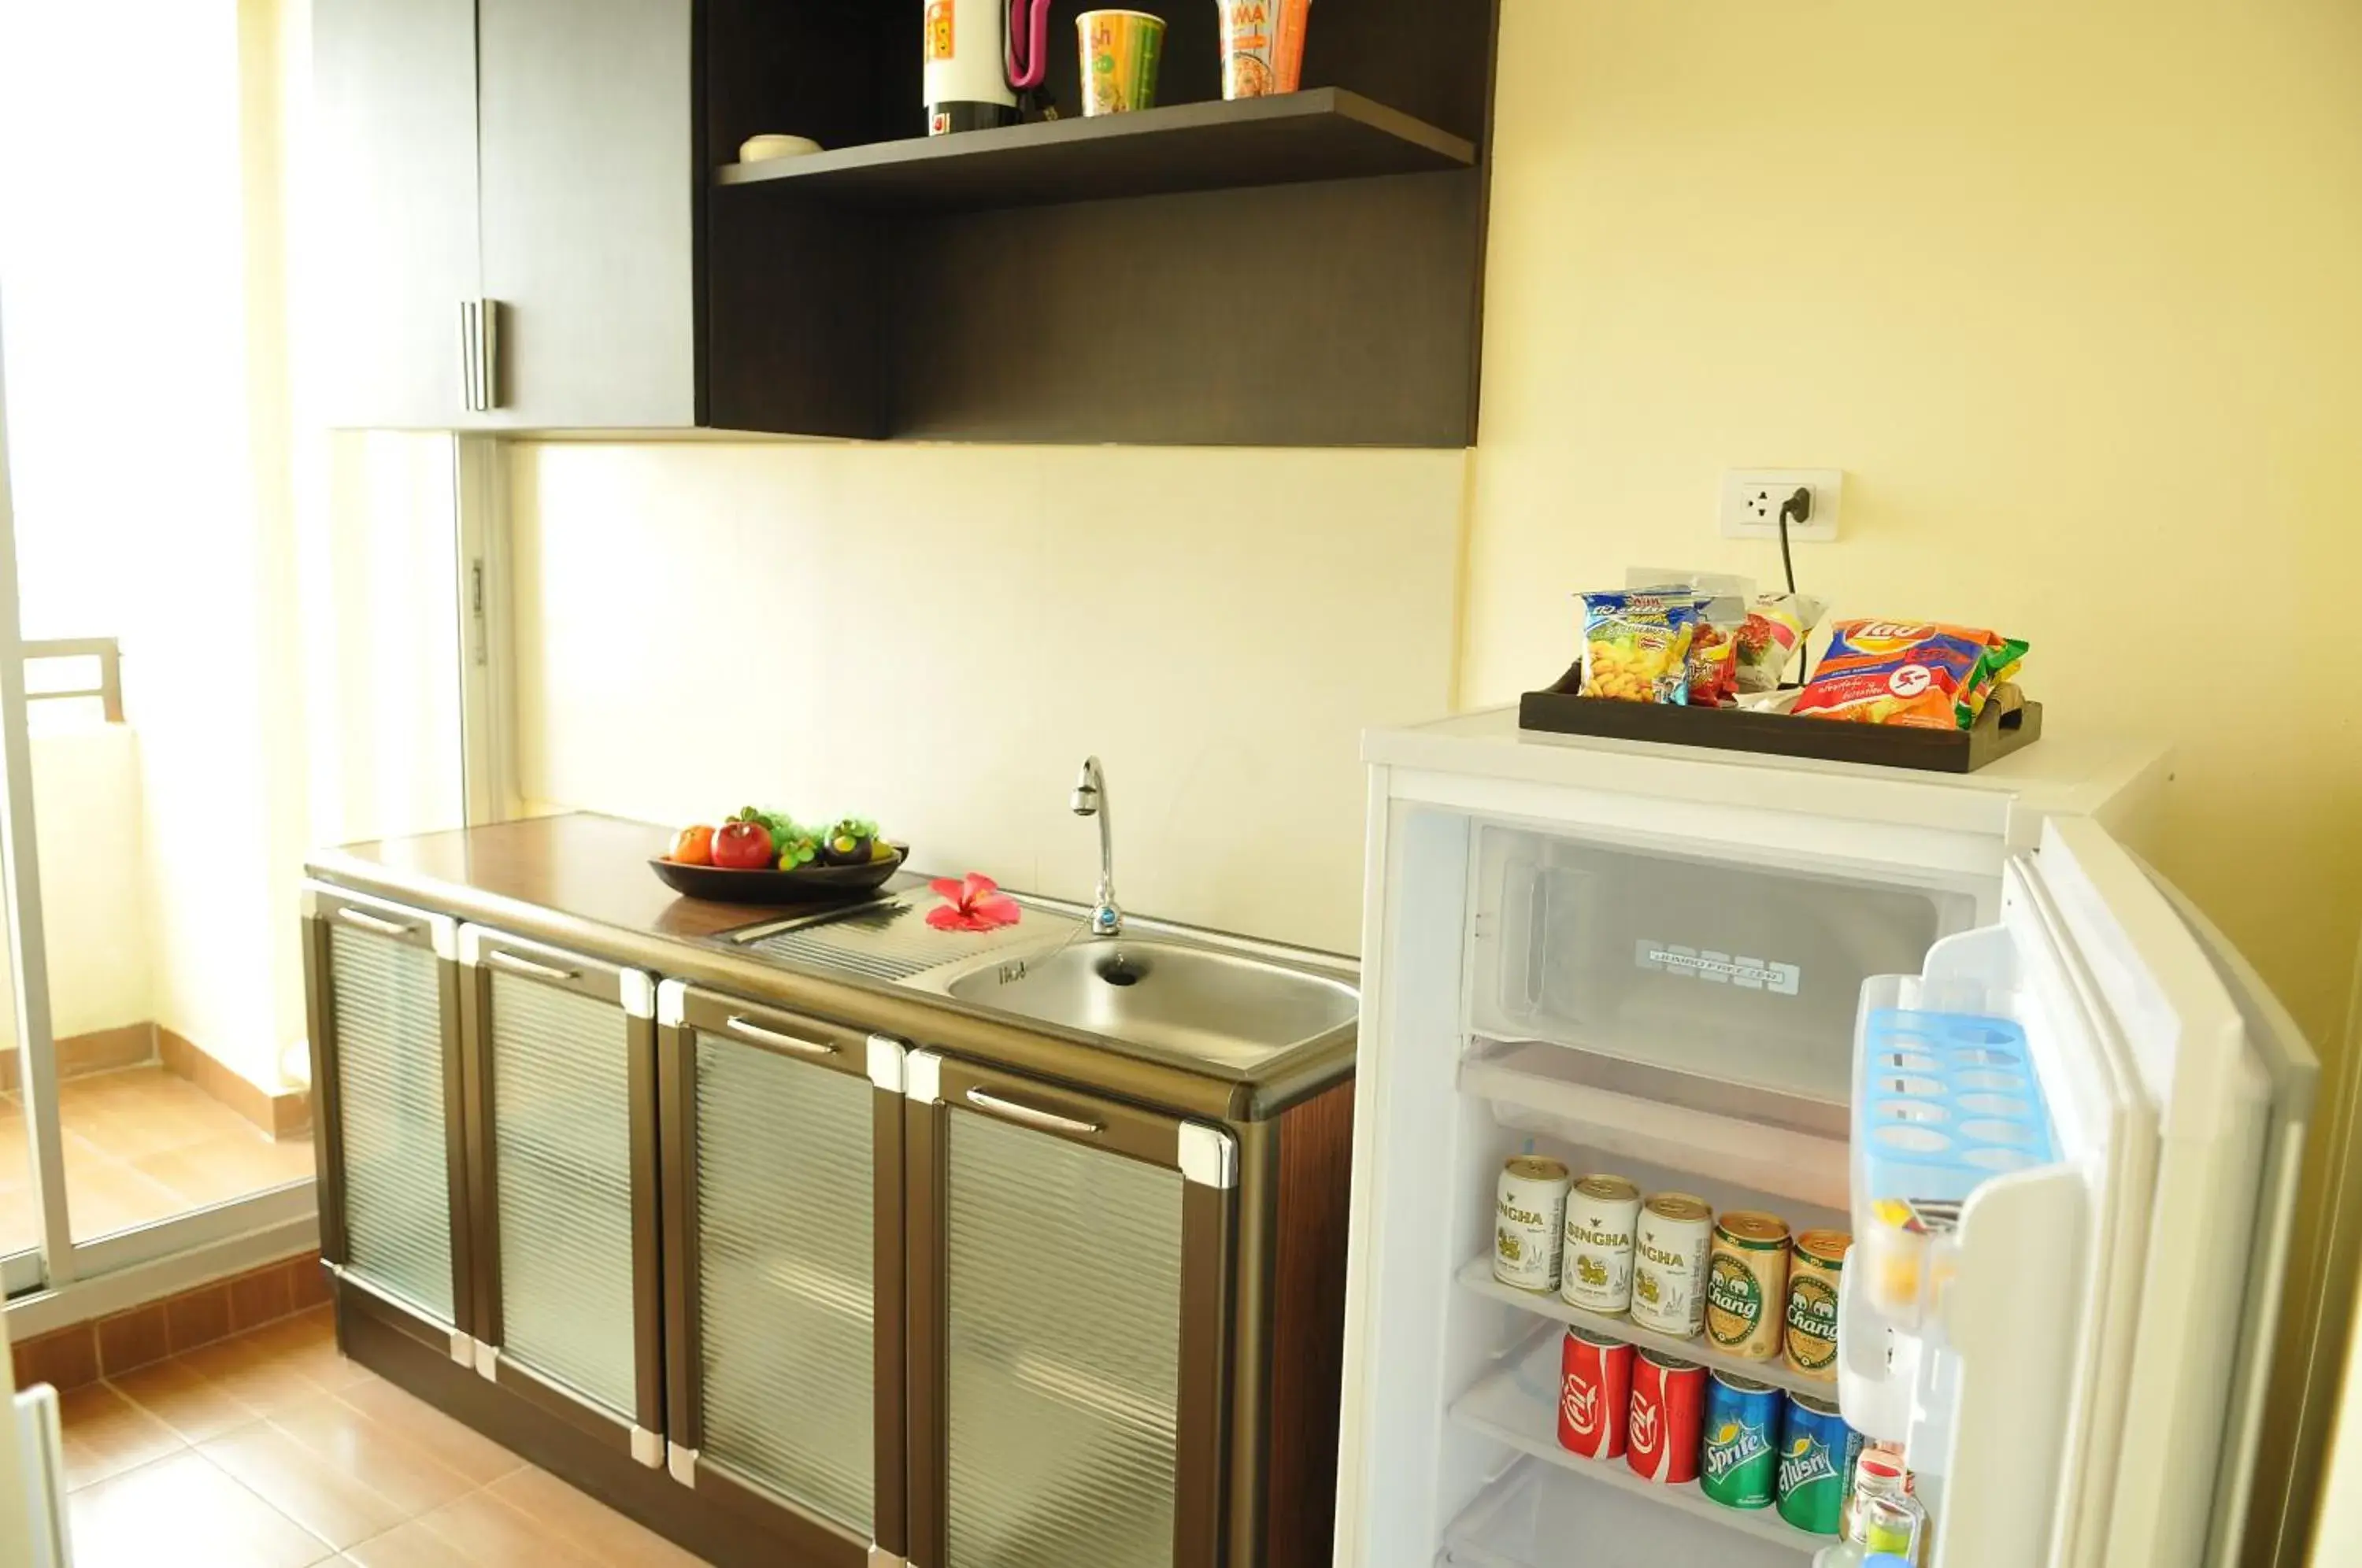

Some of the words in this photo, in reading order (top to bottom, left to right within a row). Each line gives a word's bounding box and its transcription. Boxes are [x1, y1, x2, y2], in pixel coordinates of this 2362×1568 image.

[1498, 1200, 1543, 1226] NGHA
[1567, 1221, 1629, 1246] SINGHA
[1637, 1237, 1684, 1267] NGHA
[1708, 1281, 1757, 1318] Chang
[1787, 1304, 1838, 1344] Chang
[1708, 1433, 1757, 1474] Sprite
